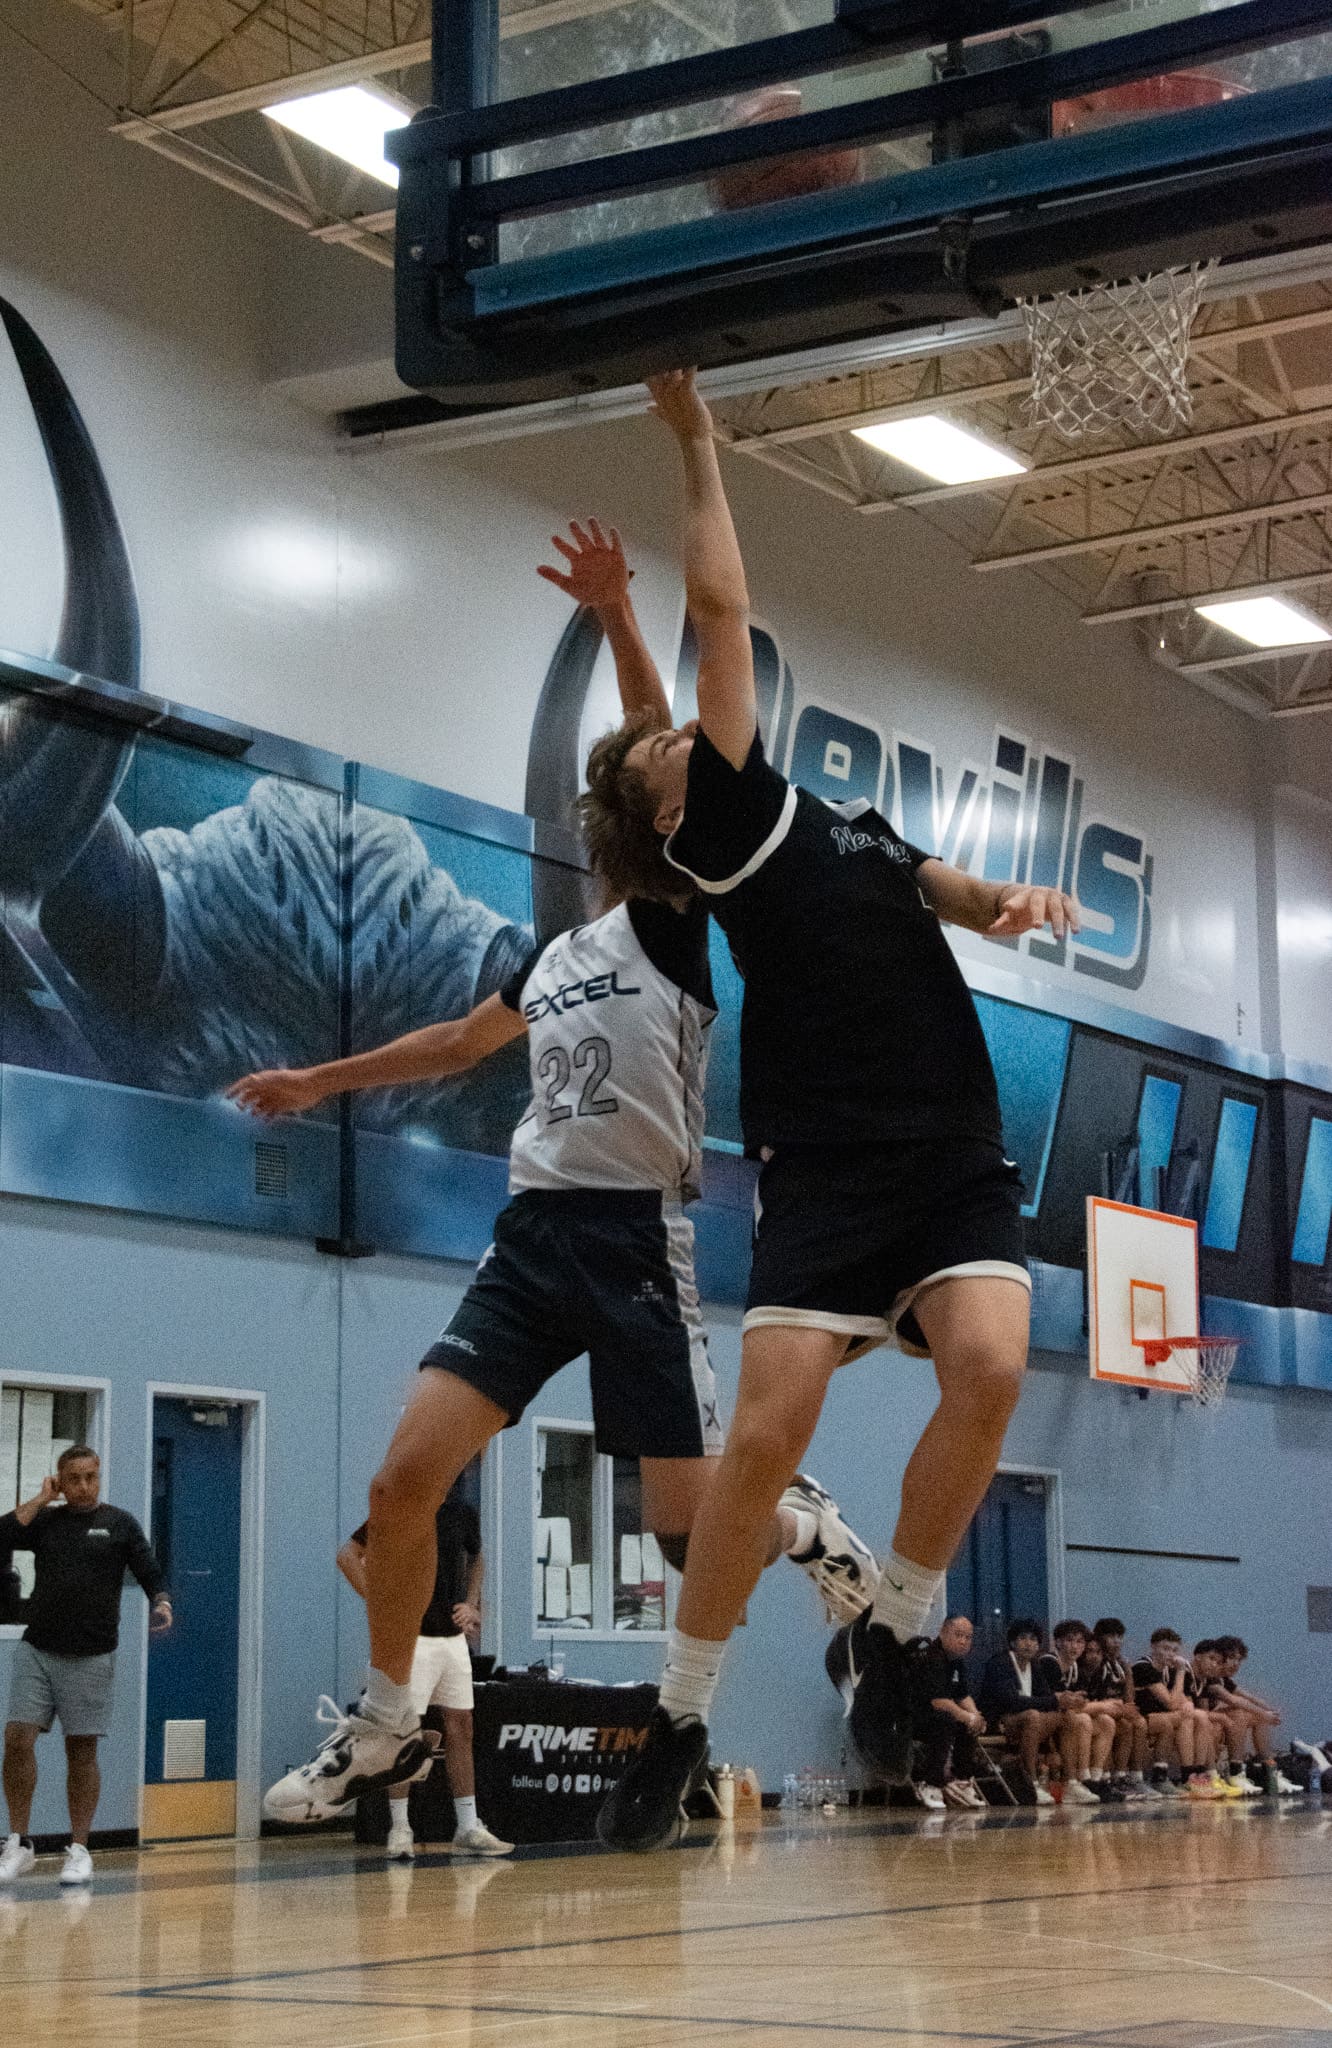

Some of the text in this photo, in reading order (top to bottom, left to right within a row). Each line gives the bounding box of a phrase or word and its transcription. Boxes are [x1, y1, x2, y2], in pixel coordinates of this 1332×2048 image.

[525, 971, 641, 1024] EXCEL
[537, 1036, 620, 1125] 22
[498, 1724, 651, 1763] PRIMETIM
